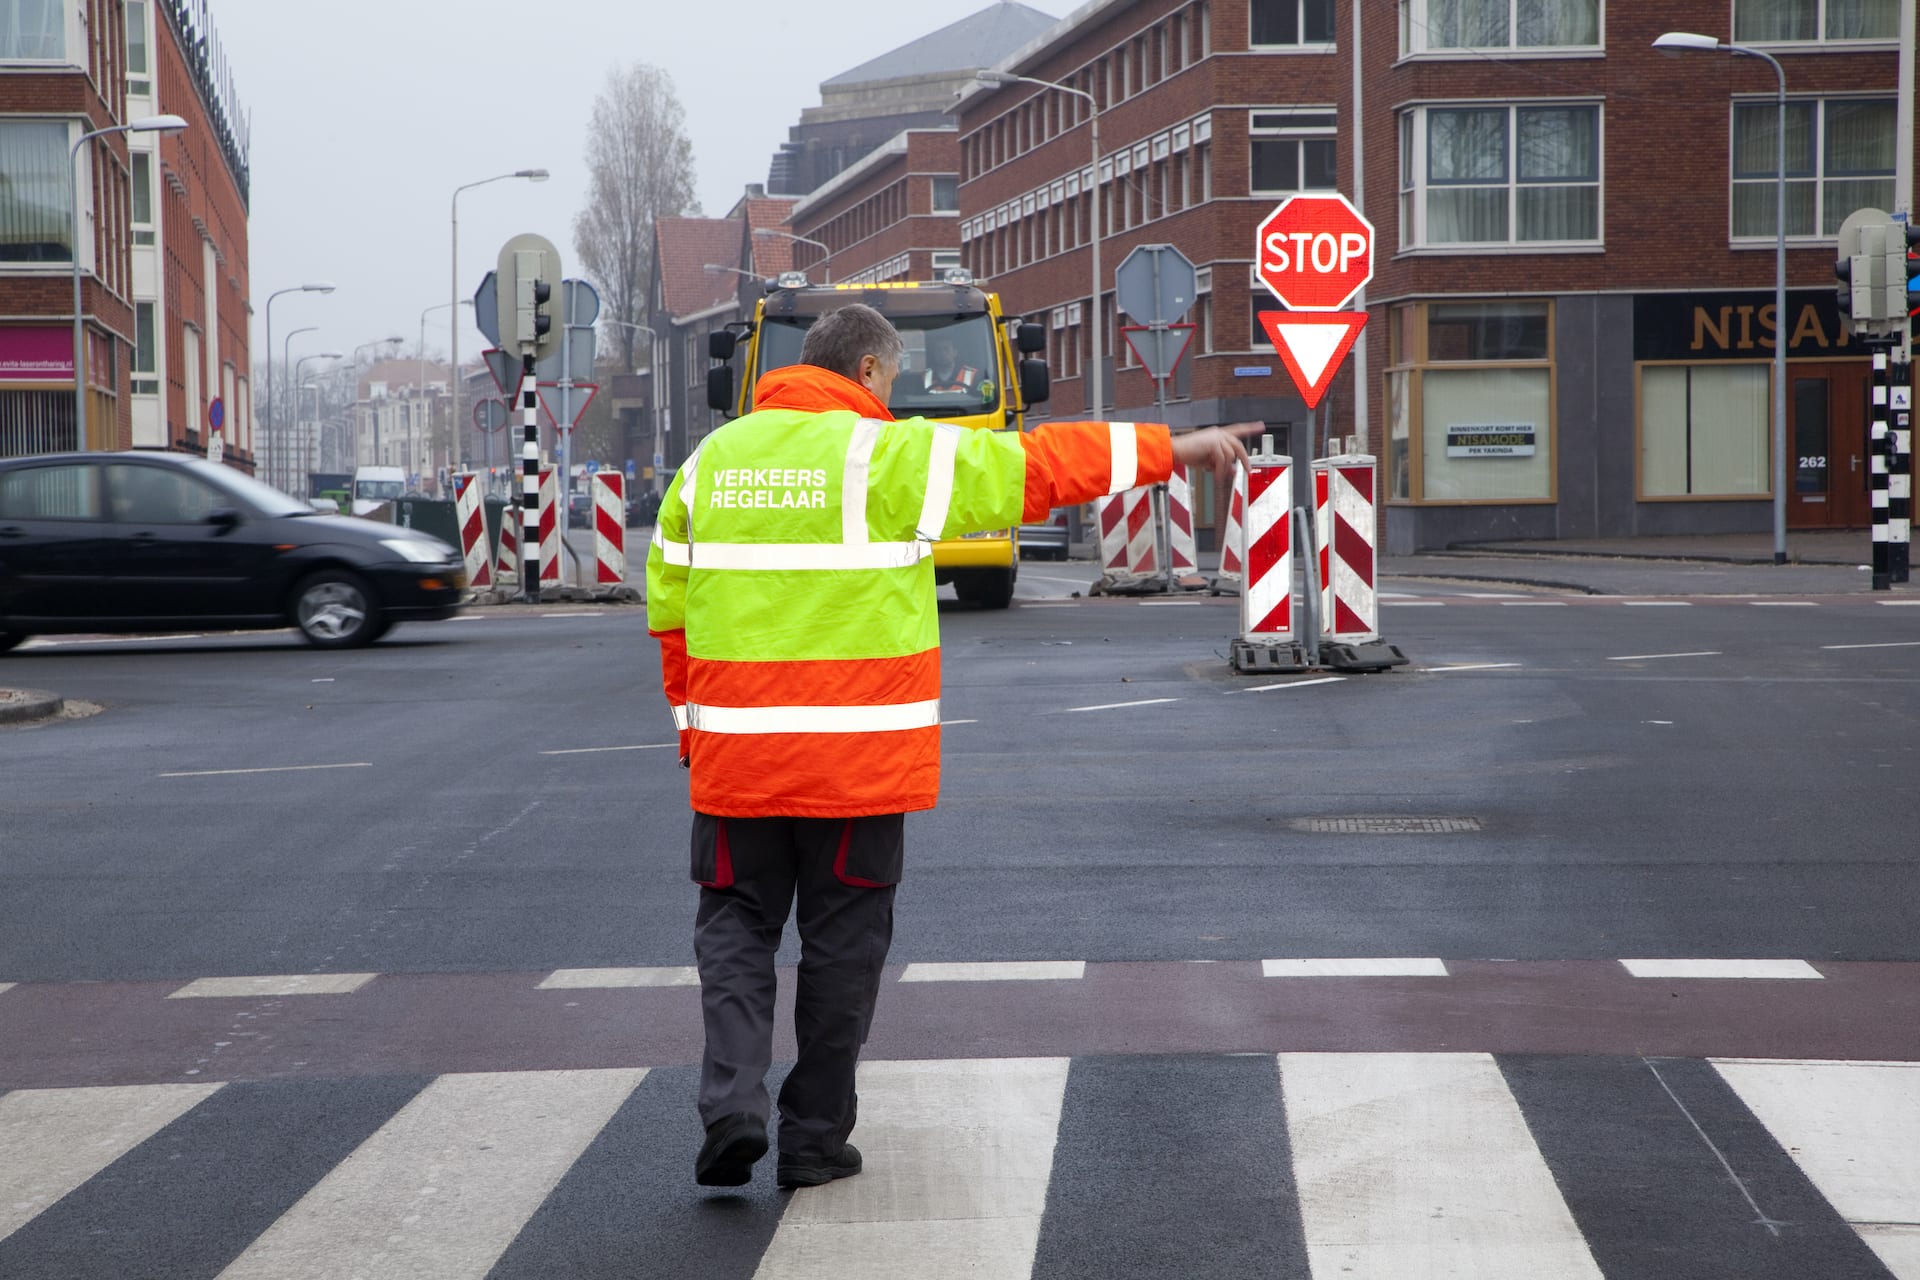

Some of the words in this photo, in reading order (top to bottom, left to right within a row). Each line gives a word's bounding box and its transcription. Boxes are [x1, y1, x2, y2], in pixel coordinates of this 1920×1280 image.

[1264, 232, 1367, 273] STOP
[1690, 303, 1920, 349] NISA
[1456, 434, 1525, 446] NISAMODE
[1799, 456, 1826, 468] 262
[713, 468, 826, 488] VERKEERS
[709, 489, 826, 509] REGELAAR
